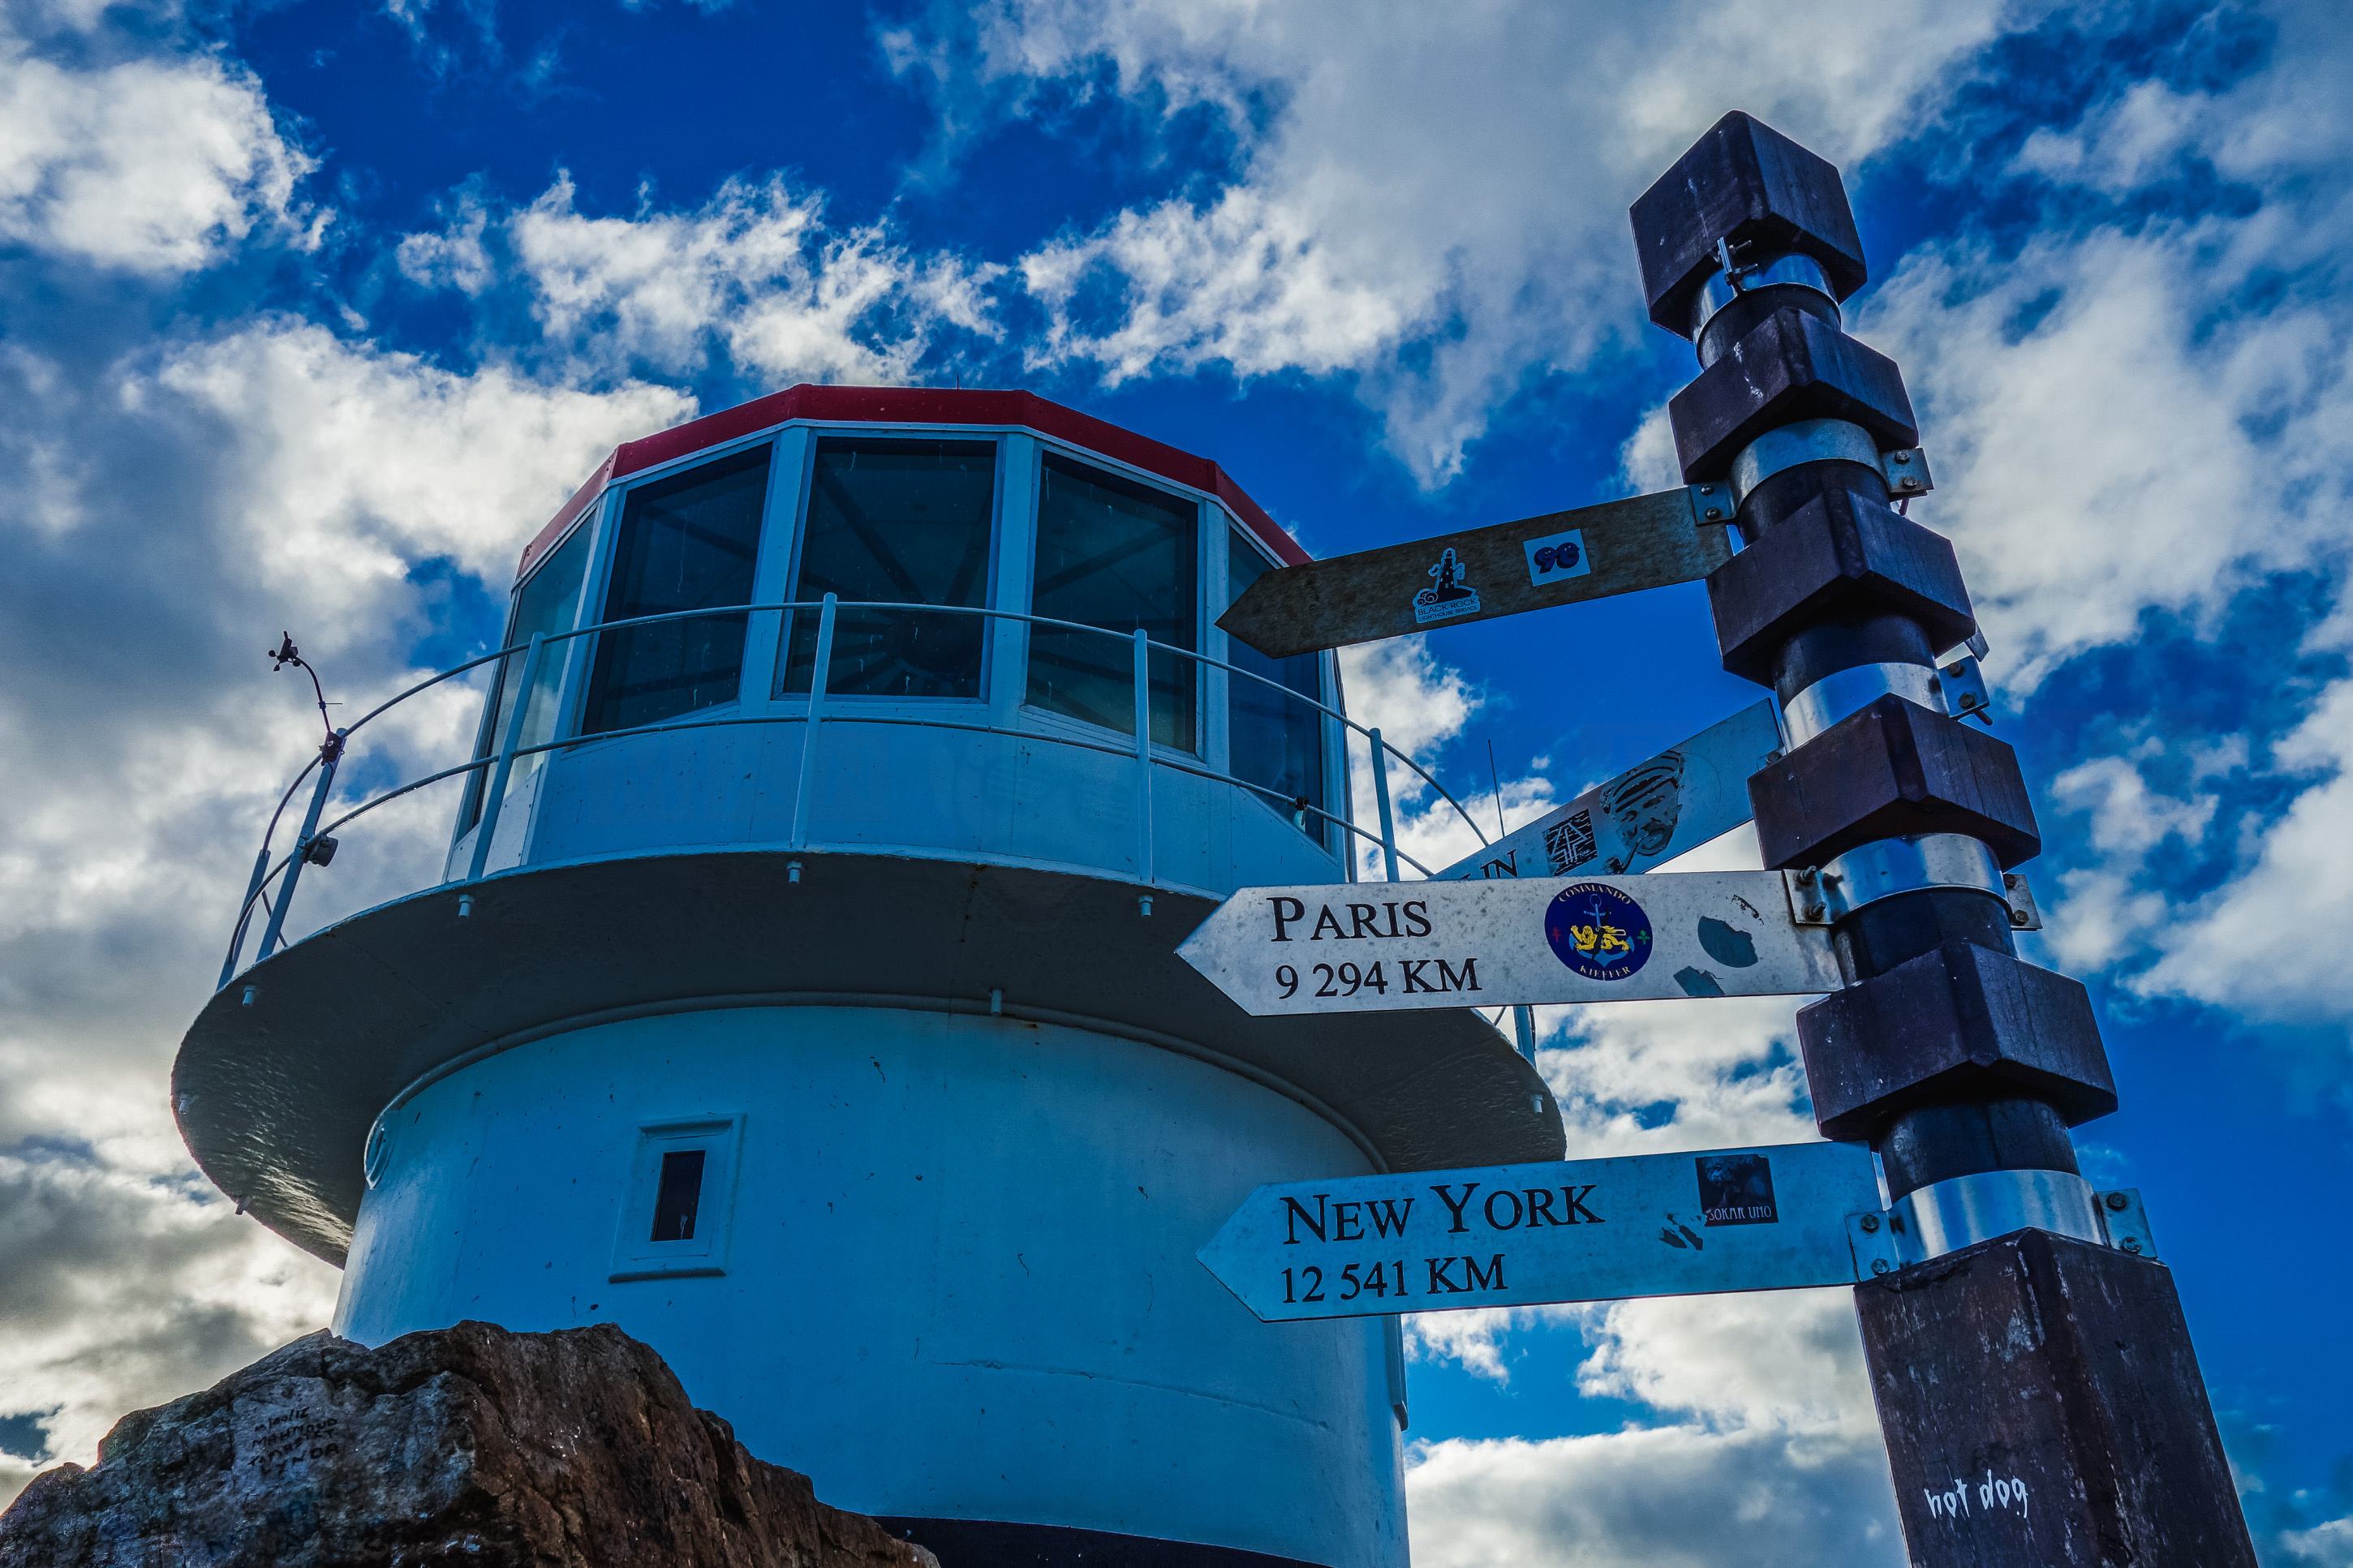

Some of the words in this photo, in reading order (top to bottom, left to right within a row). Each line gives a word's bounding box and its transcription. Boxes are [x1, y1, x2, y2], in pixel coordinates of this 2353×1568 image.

[1418, 604, 1448, 616] BLACK
[1451, 597, 1477, 609] ROCK
[1418, 611, 1454, 621] LIGHTHOUSE
[1455, 605, 1478, 614] SERVICE
[1559, 884, 1631, 904] COMMANDO
[1266, 896, 1432, 942] PARIS
[1275, 964, 1299, 999] 9
[1312, 960, 1388, 997] 294
[1397, 957, 1483, 994] KM
[1580, 964, 1631, 978] KIEFFER
[1280, 1193, 1416, 1245] NEW
[1429, 1182, 1606, 1234] YORK
[1706, 1206, 1745, 1221] SOKAR
[1748, 1205, 1772, 1218] UNO
[1281, 1265, 1326, 1304] 12
[1340, 1259, 1409, 1301] 541
[1424, 1253, 1509, 1295] KM
[1924, 1478, 1970, 1519] hot
[1979, 1468, 2028, 1519] dog
